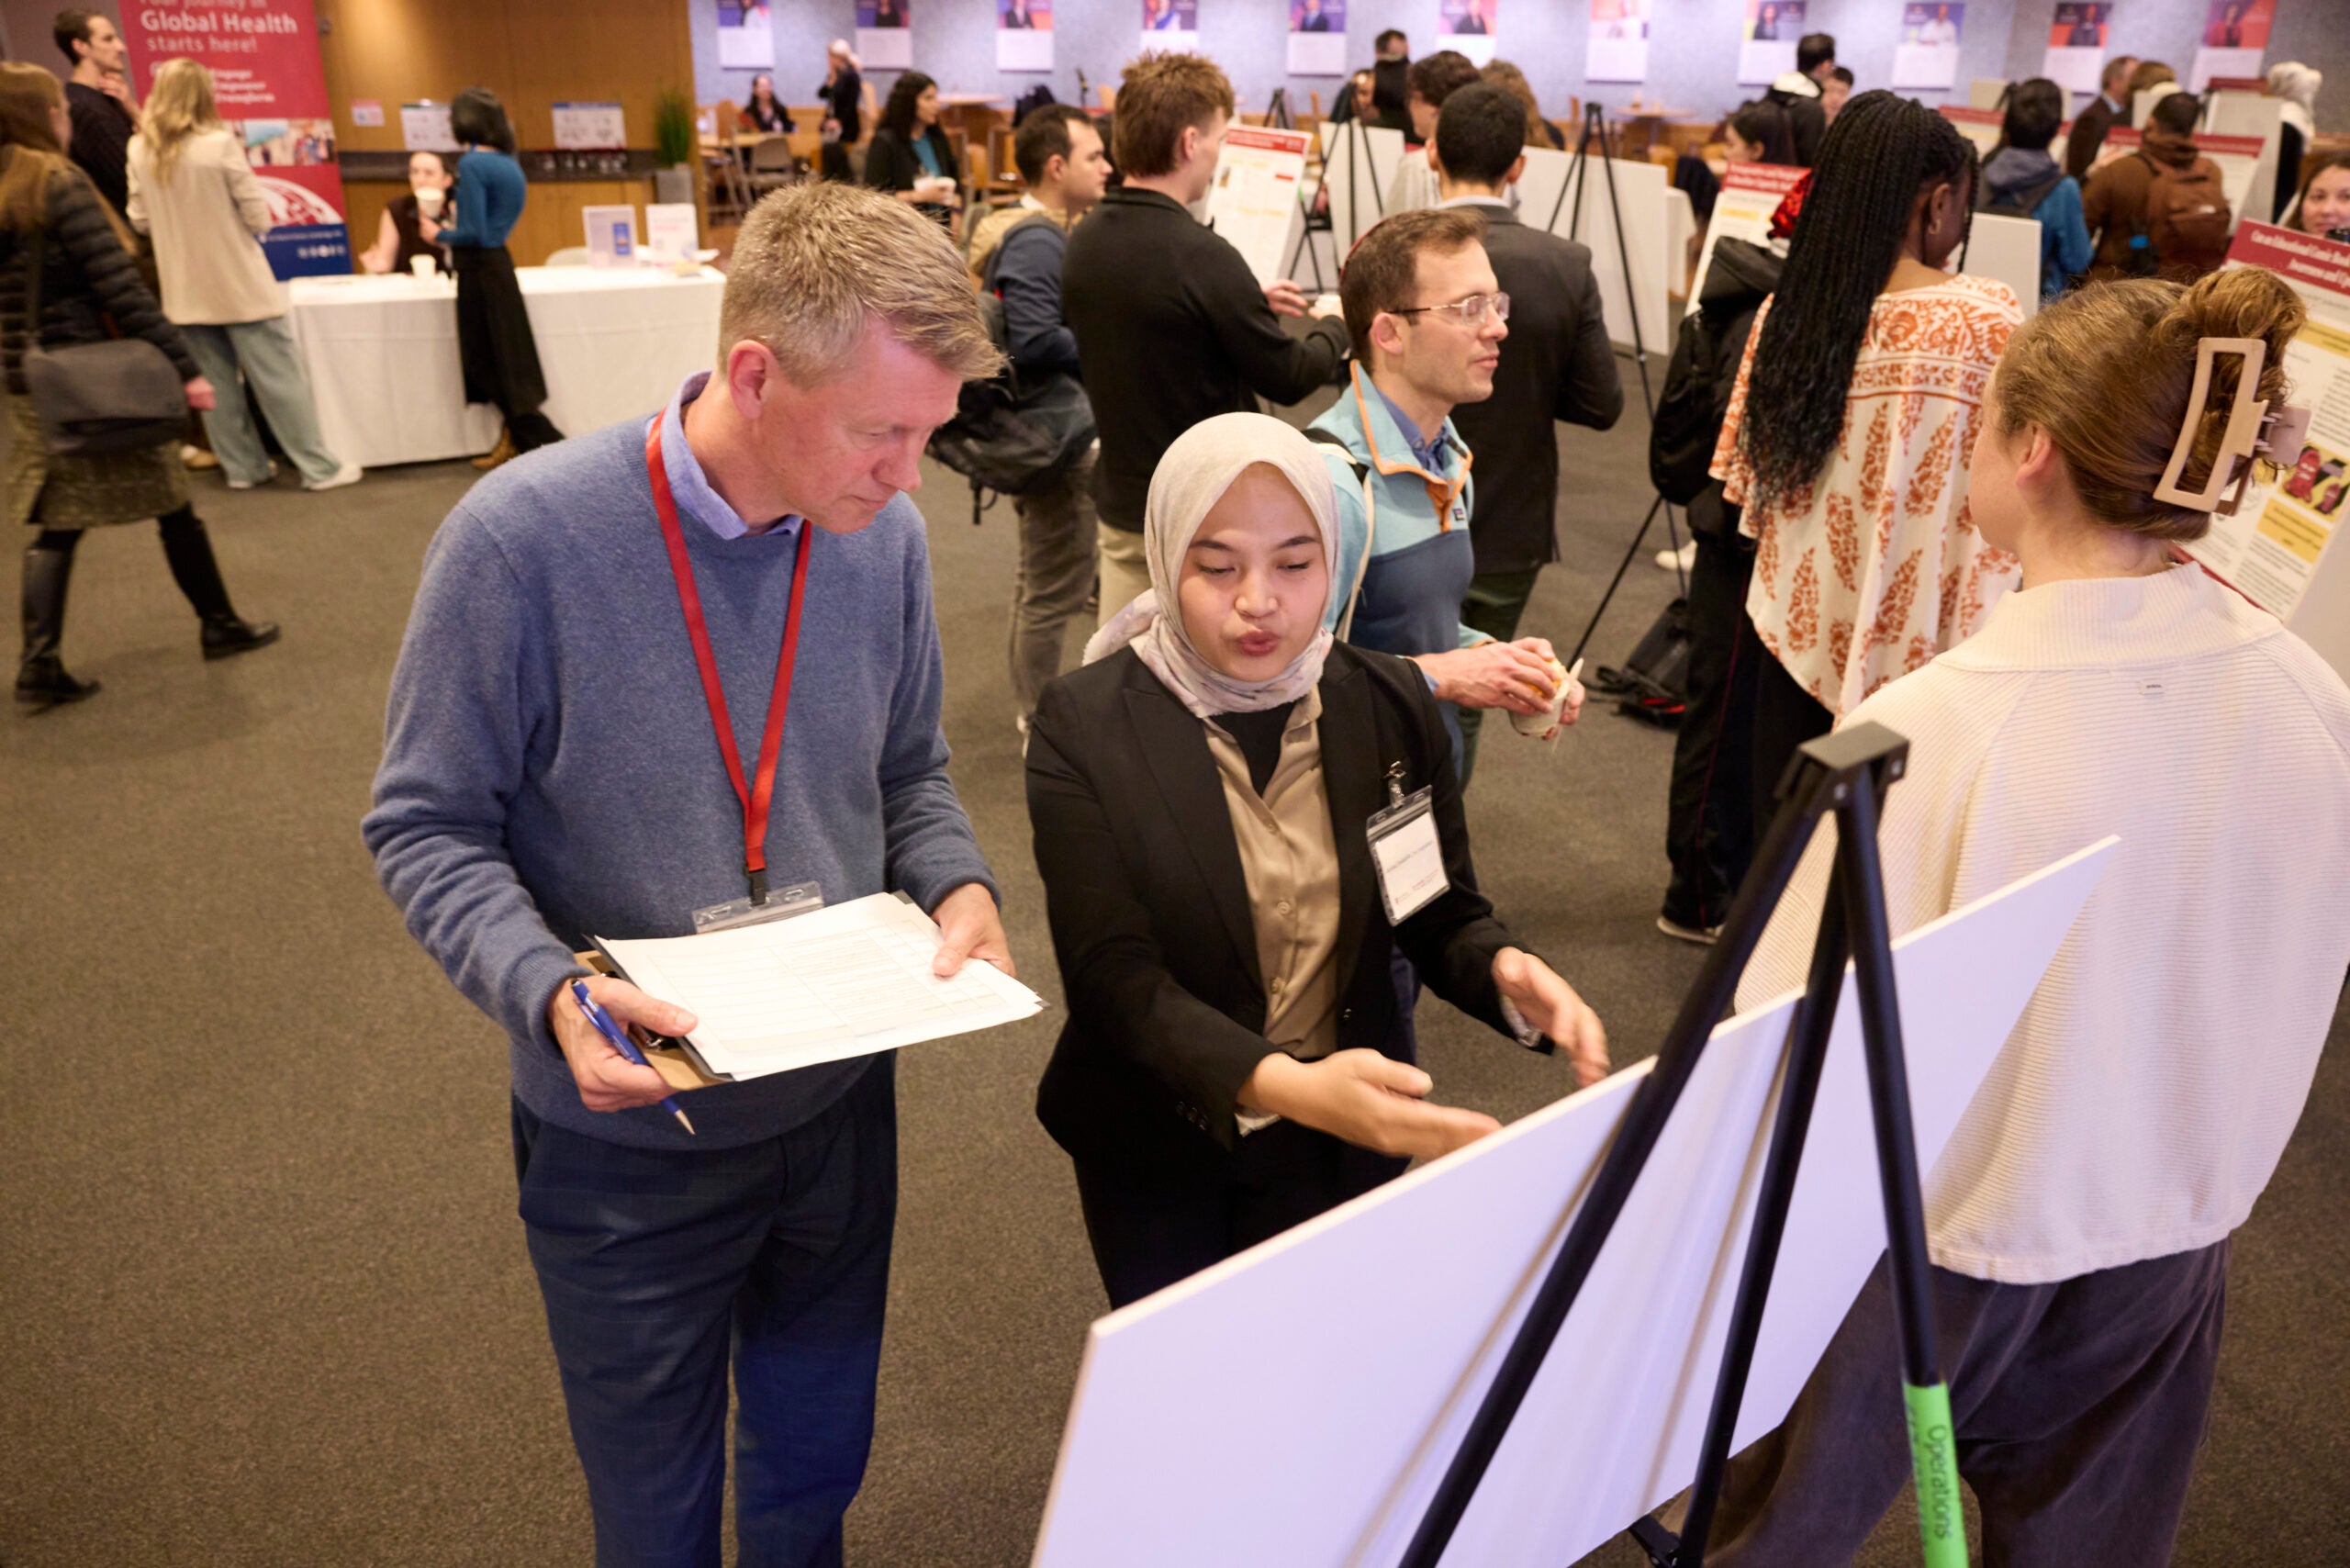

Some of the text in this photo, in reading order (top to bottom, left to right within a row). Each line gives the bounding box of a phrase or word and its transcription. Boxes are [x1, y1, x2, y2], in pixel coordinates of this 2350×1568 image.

[140, 10, 297, 34] Global Health
[147, 36, 258, 52] starts here!
[1924, 1426, 1952, 1540] Operations
